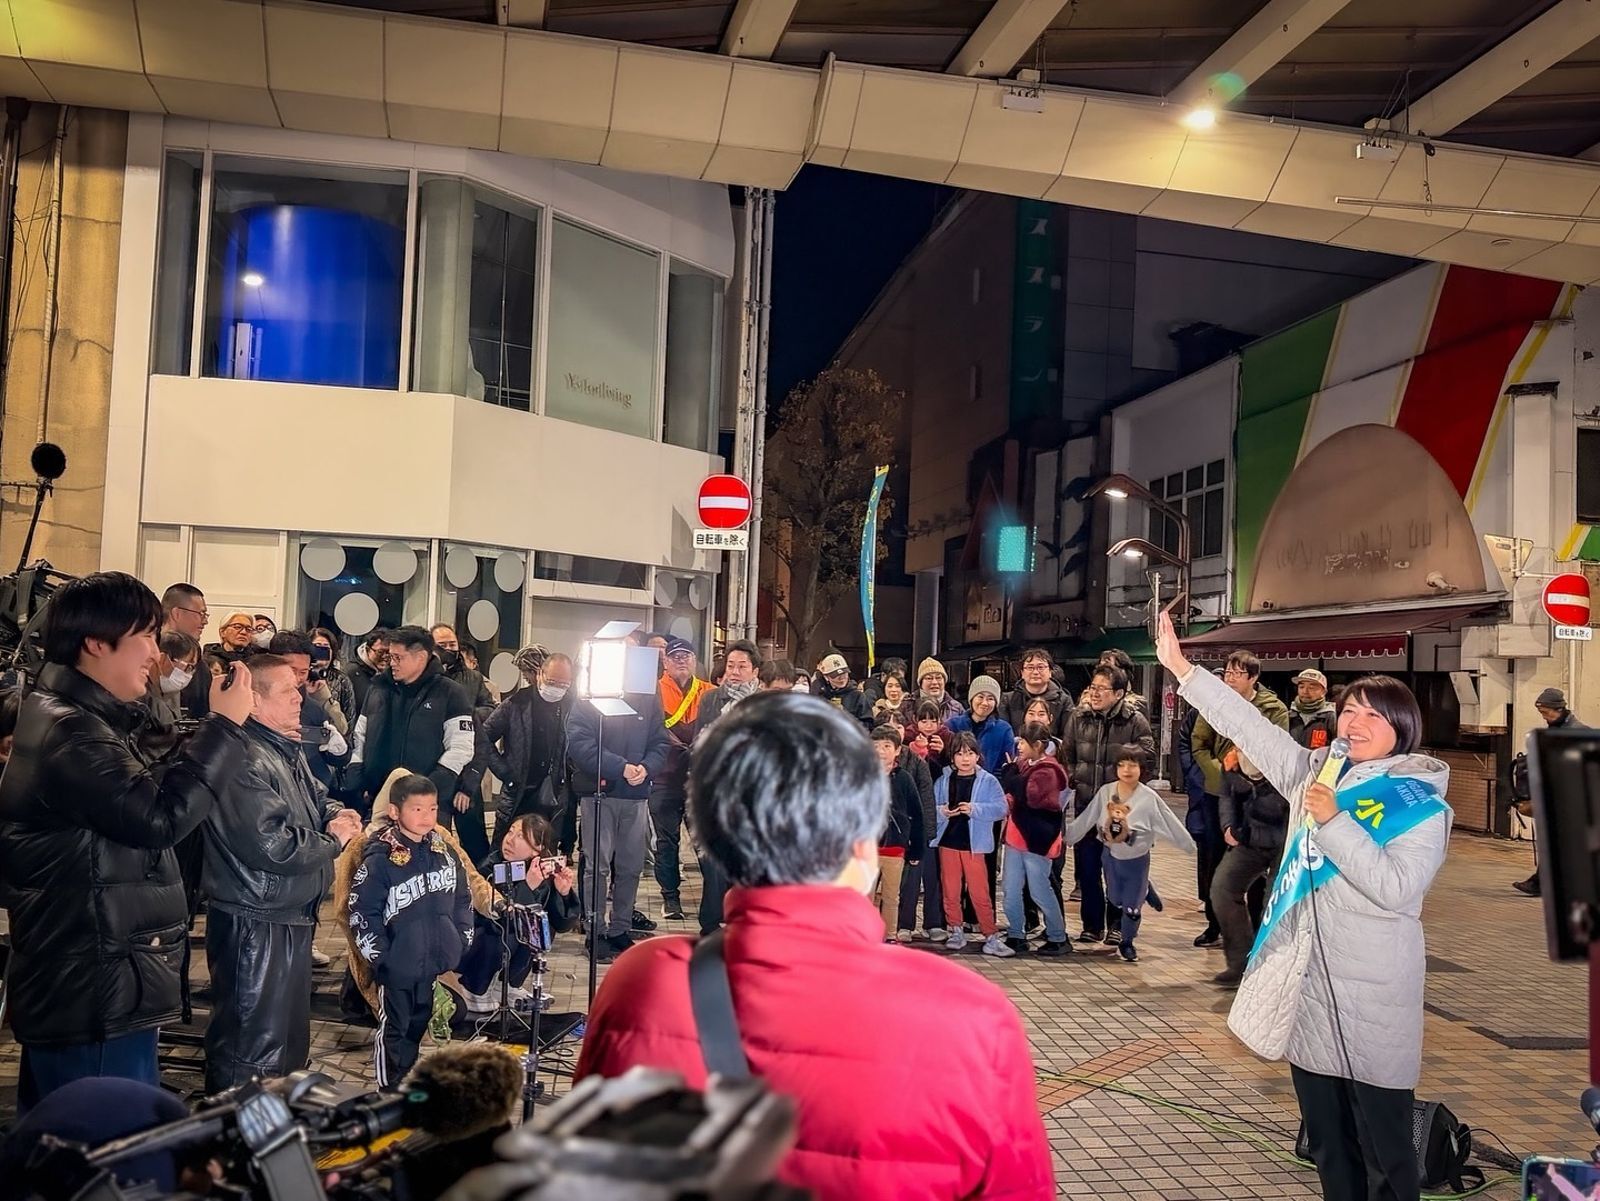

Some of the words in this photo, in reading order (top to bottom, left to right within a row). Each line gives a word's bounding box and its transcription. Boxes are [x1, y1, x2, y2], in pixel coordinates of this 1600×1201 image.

[696, 534, 744, 545] 自転車を除く
[1394, 784, 1418, 808] AKIRA
